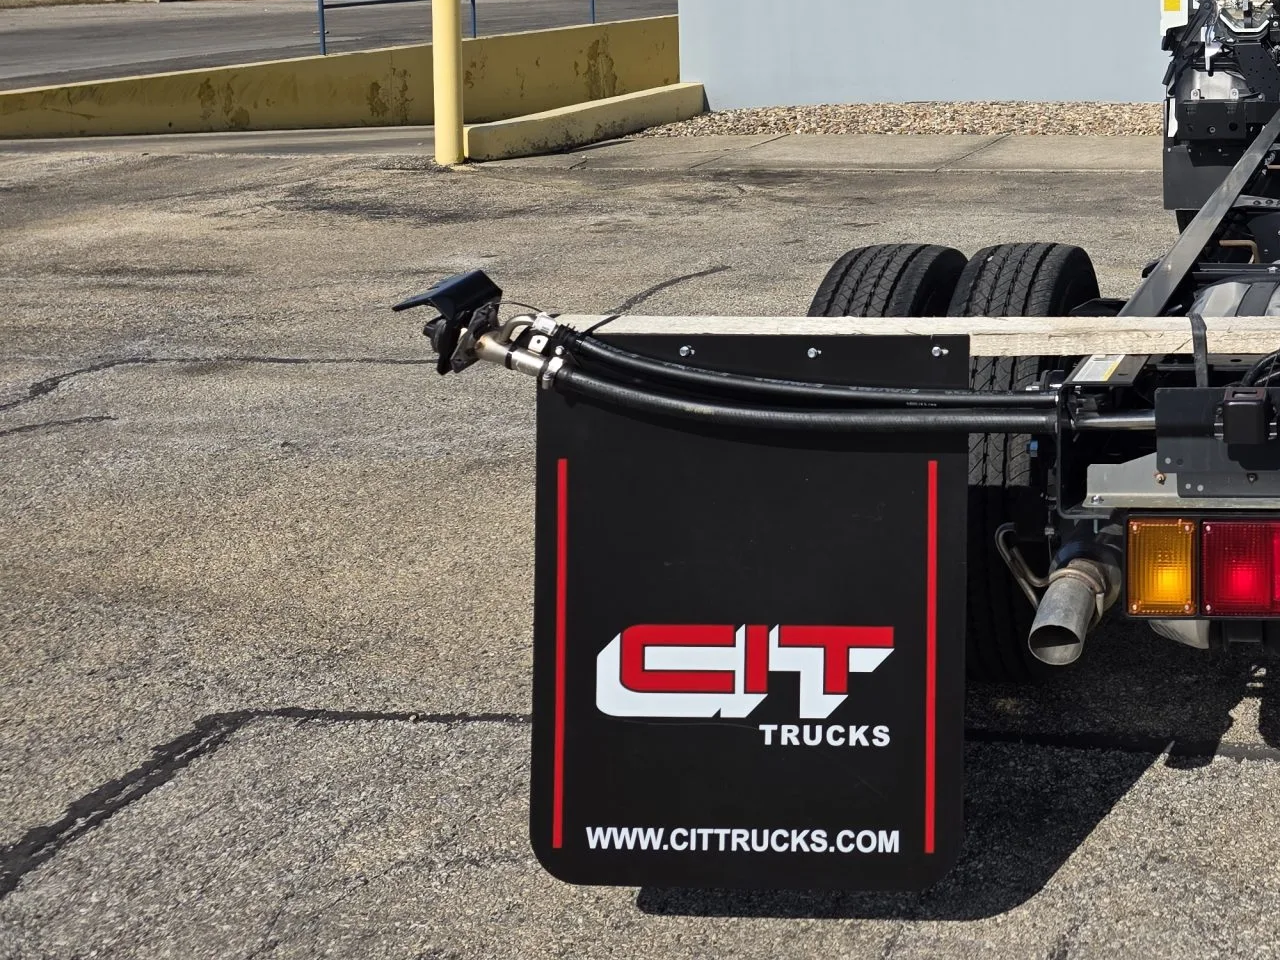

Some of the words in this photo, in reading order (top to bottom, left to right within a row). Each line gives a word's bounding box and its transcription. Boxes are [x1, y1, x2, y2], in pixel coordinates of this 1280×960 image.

[596, 624, 895, 719] CIT
[758, 724, 891, 747] TRUCKS
[586, 826, 900, 853] WWW.CITTRUCKS.COM
